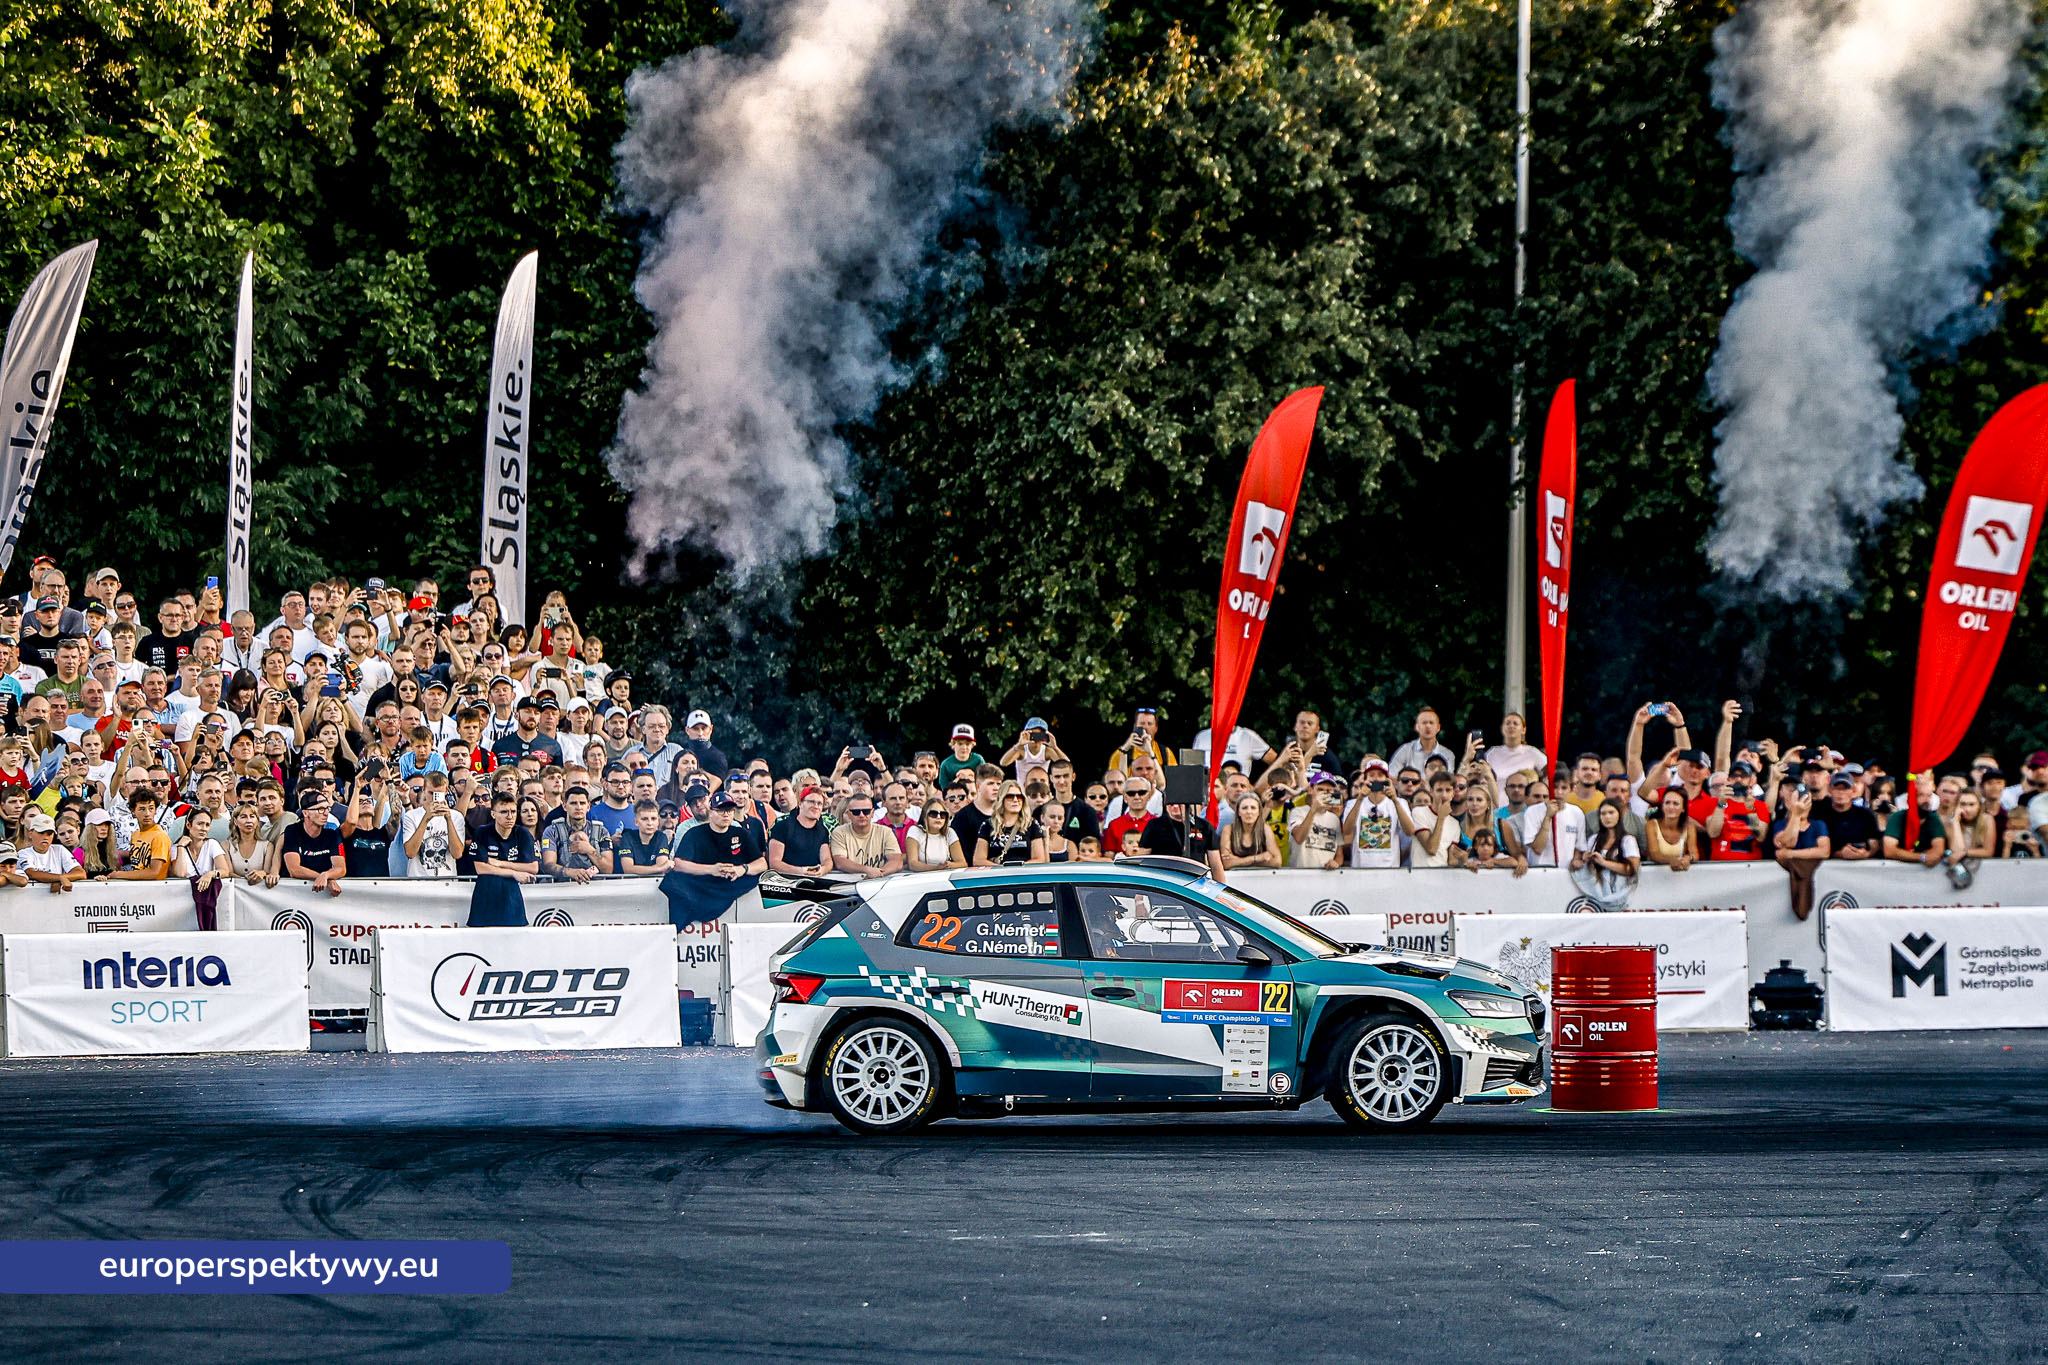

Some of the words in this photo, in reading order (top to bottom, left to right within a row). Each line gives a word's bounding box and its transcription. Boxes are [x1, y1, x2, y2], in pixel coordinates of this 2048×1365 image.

[1939, 580, 2018, 612] ORLEN
[1958, 611, 1990, 631] OIL
[74, 906, 118, 918] STADION
[120, 903, 156, 920] ŚLĄSKI
[918, 912, 963, 952] 22
[965, 939, 1044, 954] G.Németh
[1960, 945, 2042, 960] Górnośląsko
[329, 948, 371, 965] STAD
[83, 951, 232, 990] interia
[1658, 960, 1706, 980] ystyki
[1961, 961, 2048, 976] -Zagłębiows
[476, 967, 630, 995] MOTO
[1961, 976, 2034, 991] Metropolia
[1211, 988, 1243, 997] ORLEN
[1264, 983, 1289, 1012] 22
[473, 999, 616, 1018] WIZJA
[982, 990, 1063, 1016] HUN-Therm
[111, 1000, 208, 1025] SPORT
[1015, 1008, 1049, 1022] Consulting
[1218, 1014, 1261, 1023] Championship
[1588, 1021, 1628, 1032] ORLEN
[1589, 1033, 1604, 1041] OIL
